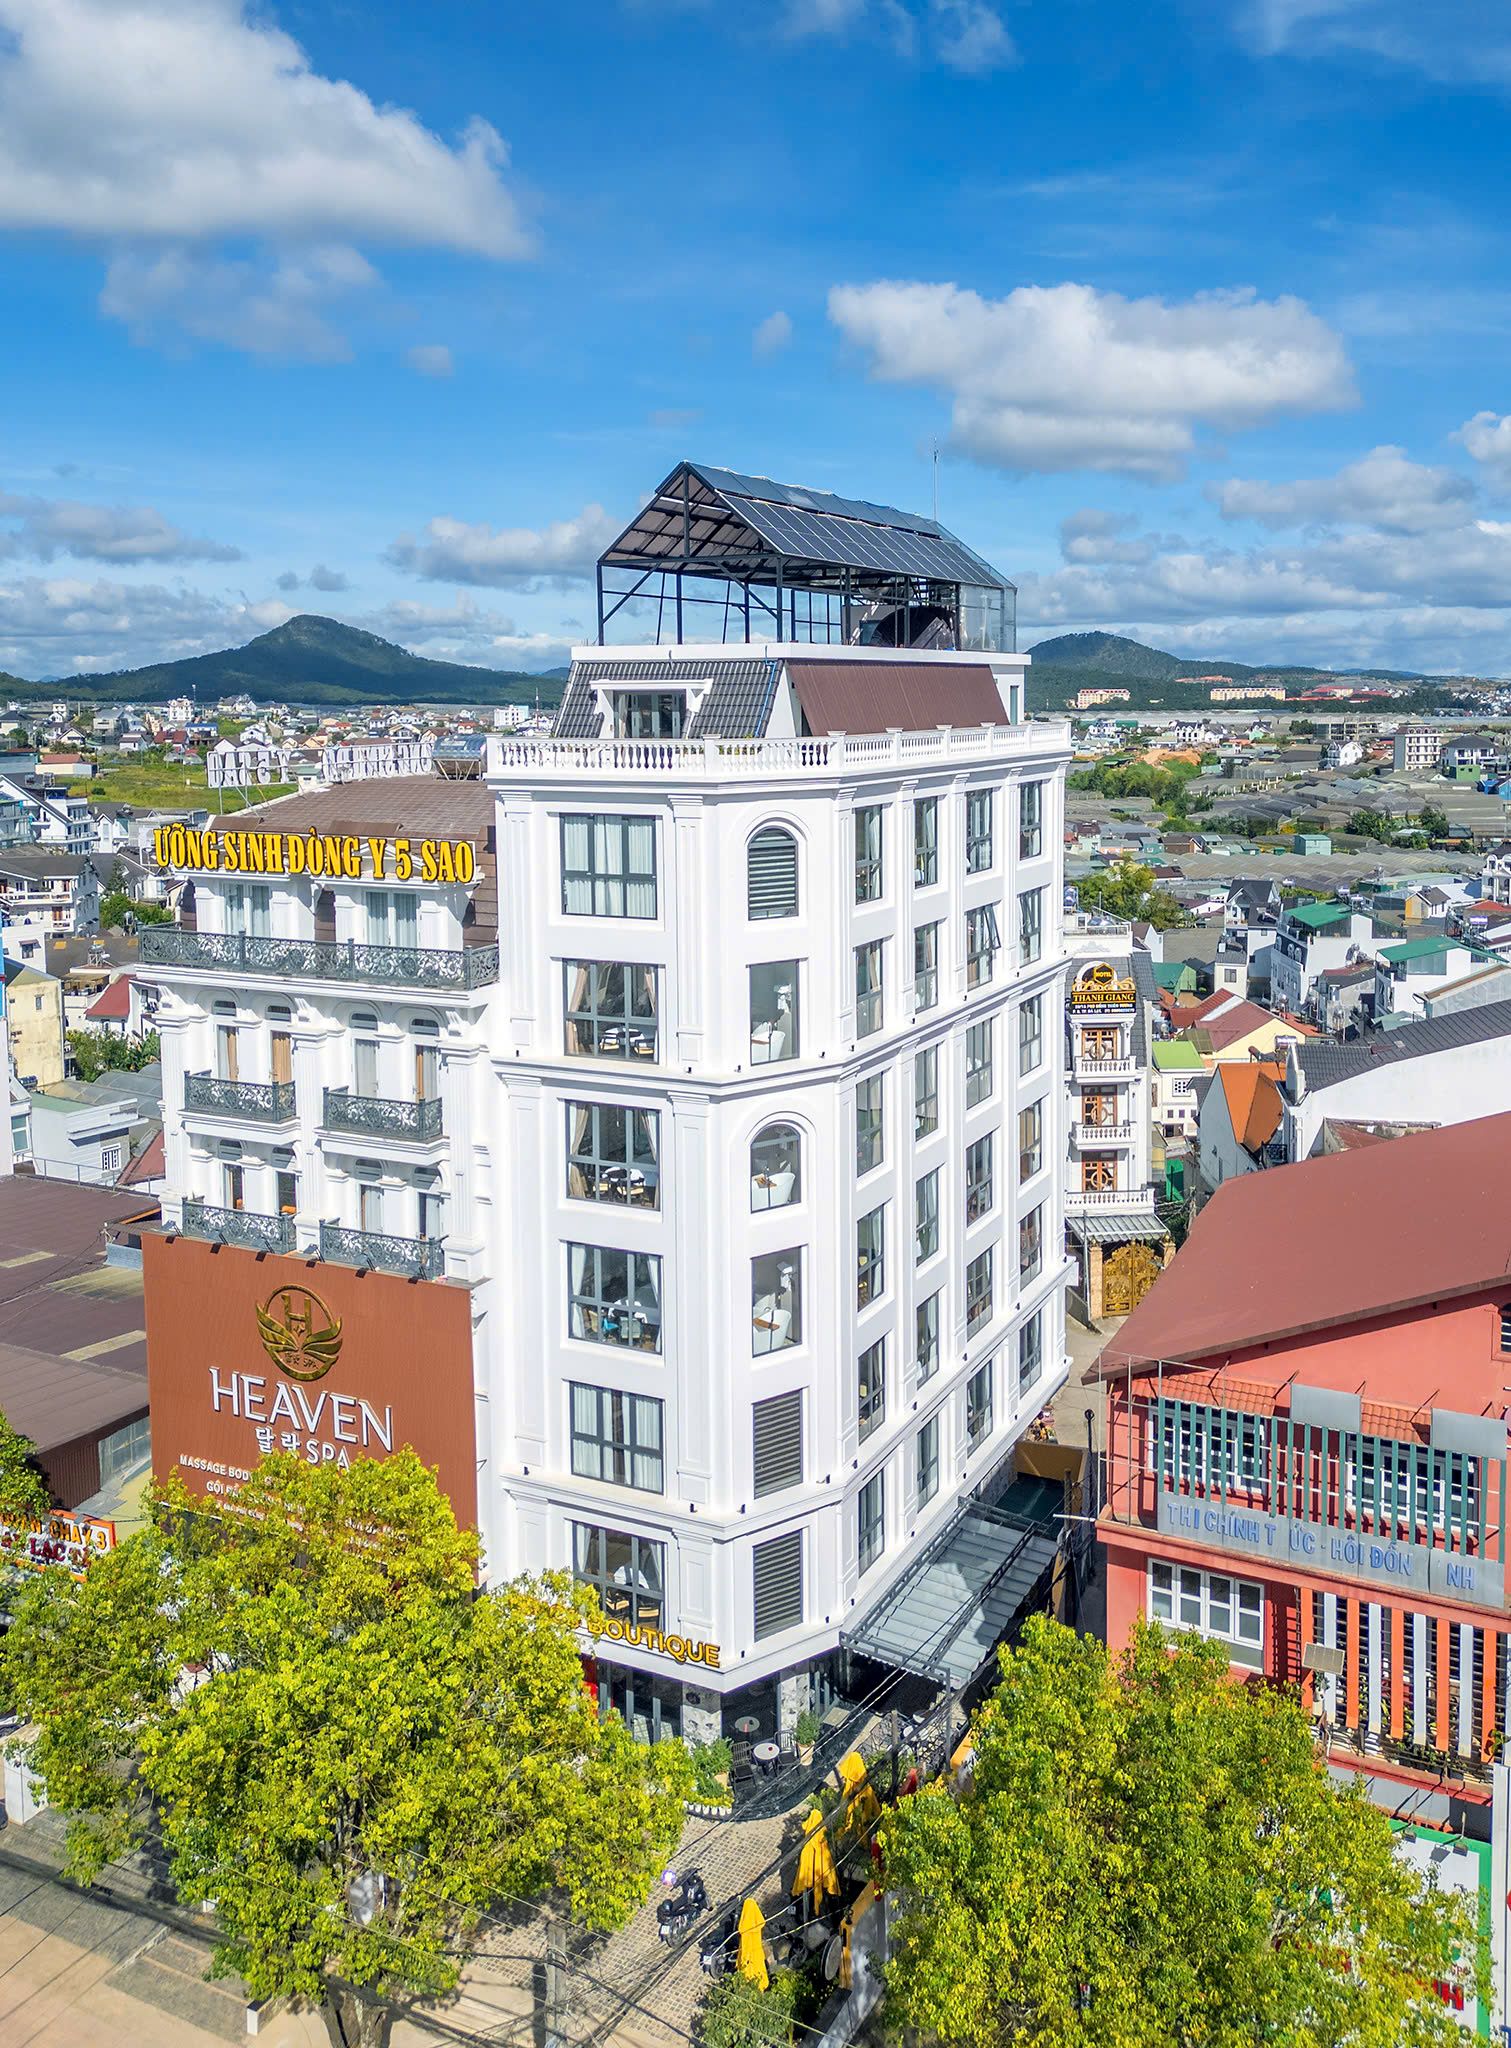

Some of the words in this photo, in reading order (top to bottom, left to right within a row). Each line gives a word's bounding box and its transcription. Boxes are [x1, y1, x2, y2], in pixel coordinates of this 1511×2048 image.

[223, 830, 284, 873] SINH
[367, 837, 387, 879] Y
[395, 839, 412, 881] 5
[421, 839, 475, 884] SAO
[1073, 994, 1104, 1002] THANH
[1105, 993, 1134, 1001] GIANG
[209, 1366, 395, 1452] HEAVEN
[179, 1453, 226, 1476] MASSAGE
[306, 1438, 351, 1473] SPA
[49, 1519, 93, 1547] CHAY
[96, 1530, 107, 1550] 3
[1167, 1502, 1200, 1530] THI
[1204, 1510, 1260, 1543] CHÍNH
[587, 1616, 720, 1668] BOUTIQUE
